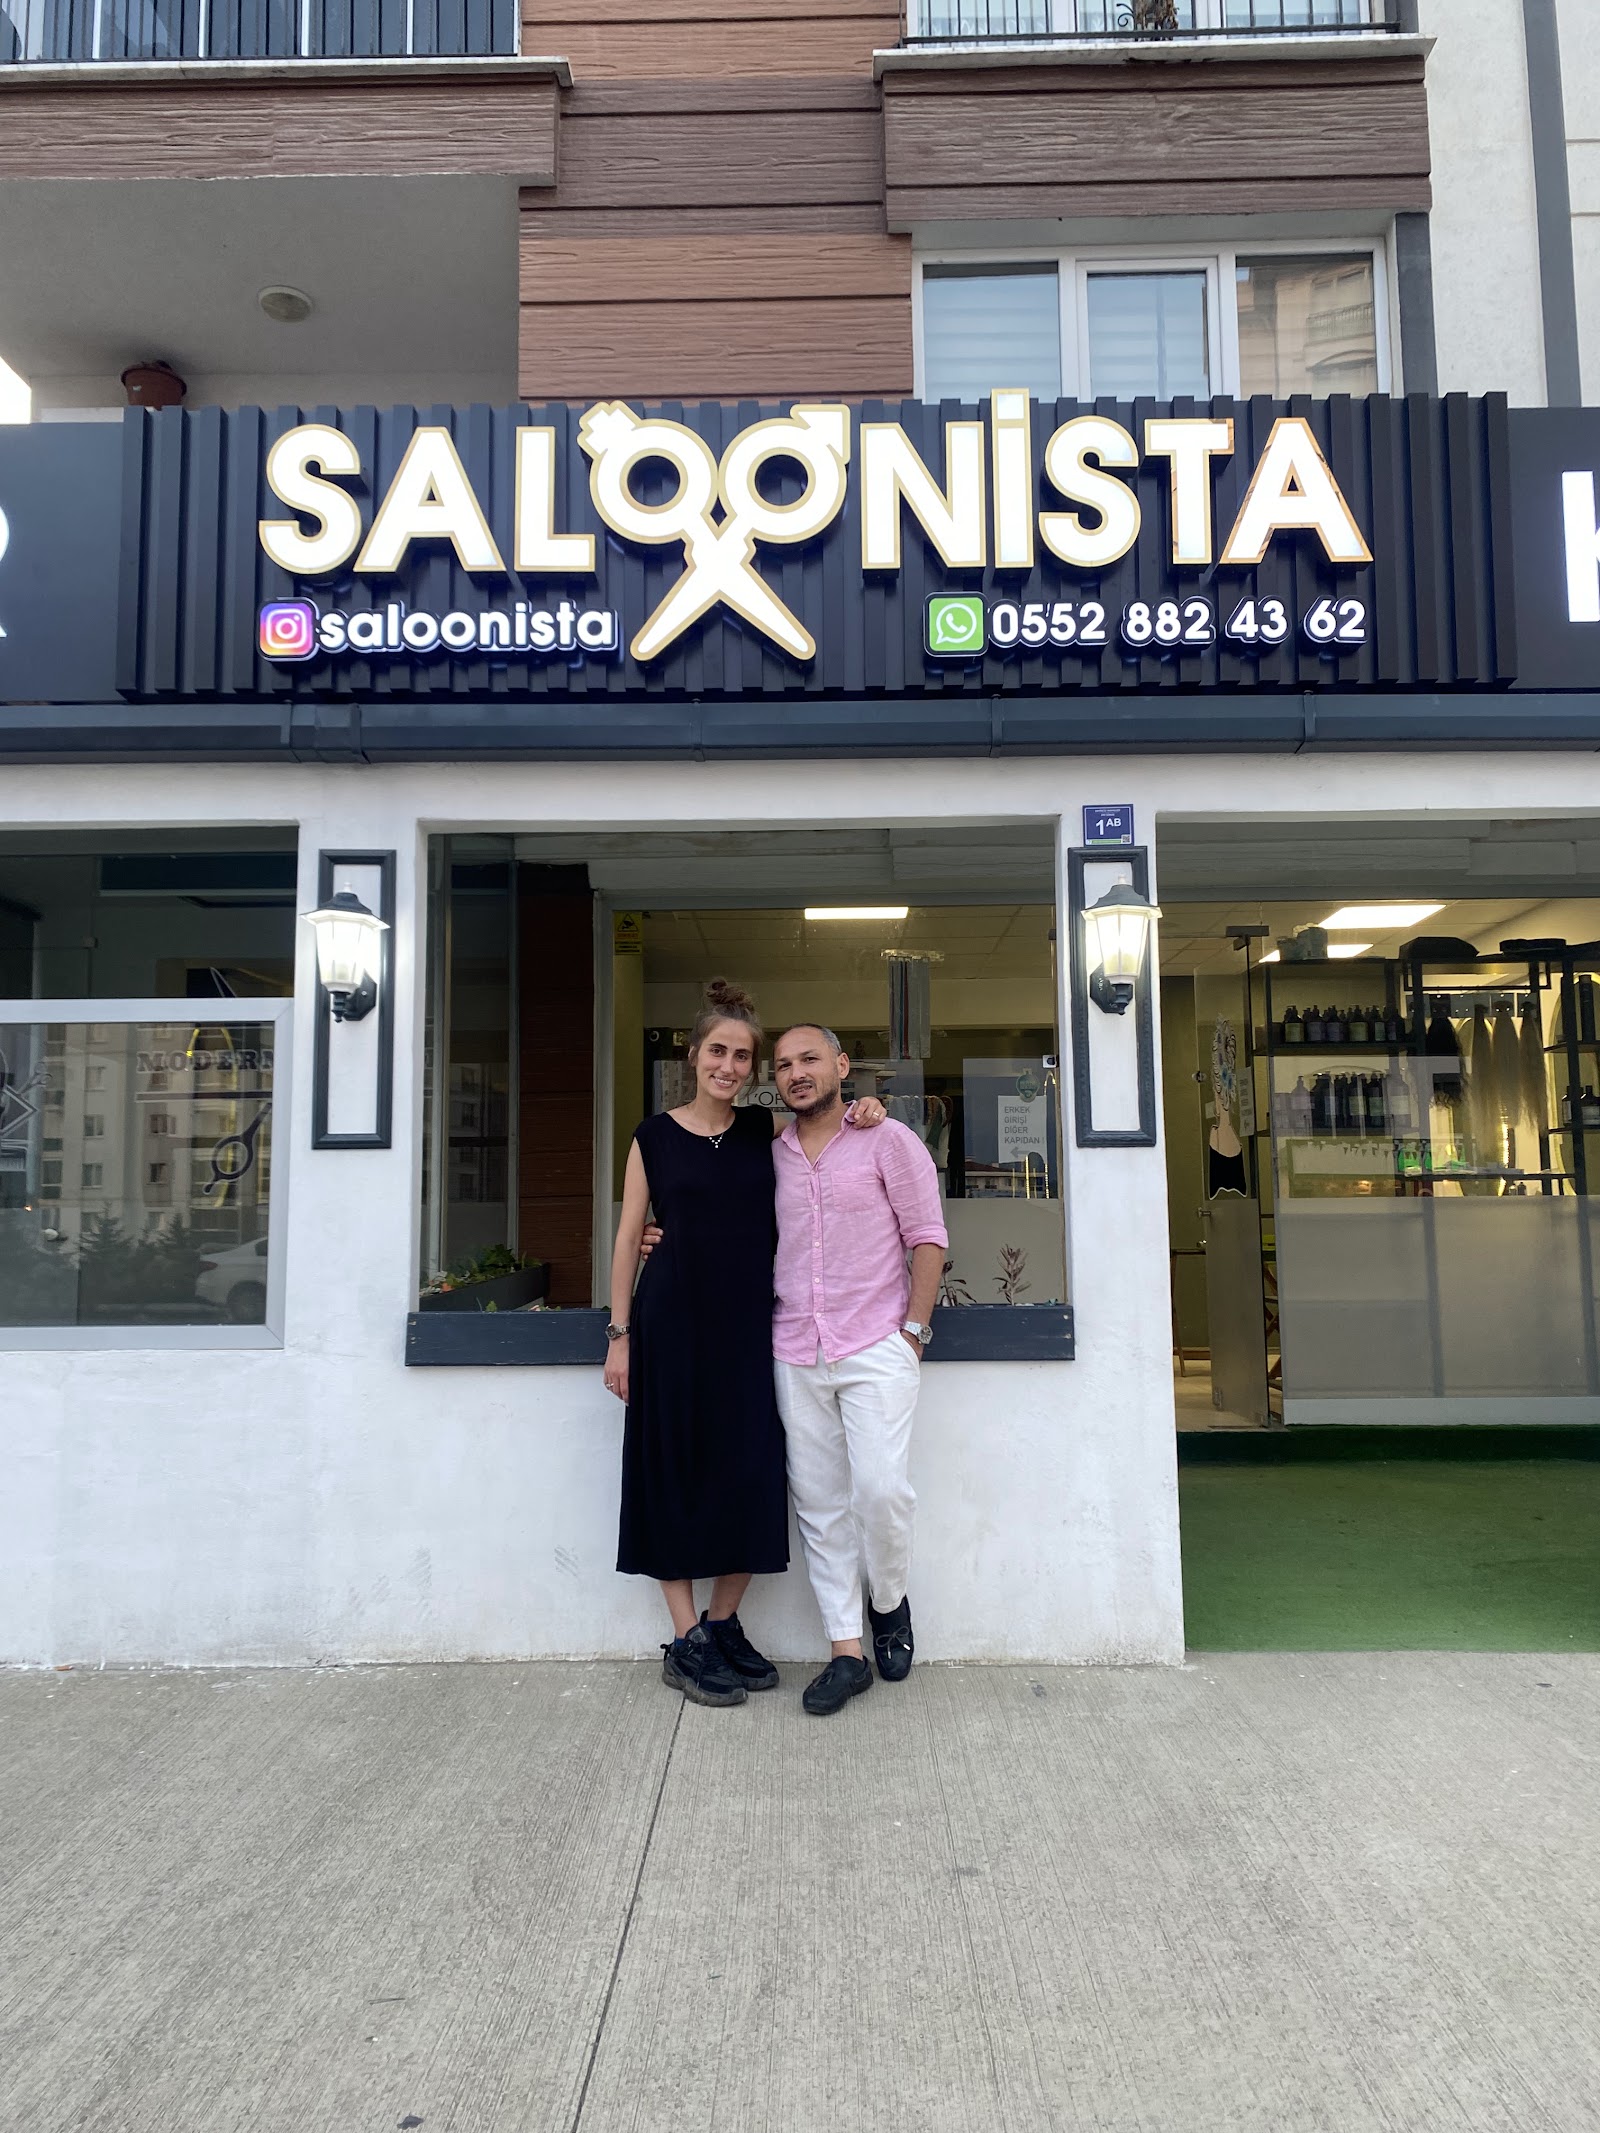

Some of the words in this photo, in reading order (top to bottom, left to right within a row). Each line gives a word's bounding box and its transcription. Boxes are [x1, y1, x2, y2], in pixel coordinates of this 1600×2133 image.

[319, 602, 614, 649] saloonista
[992, 601, 1106, 643] 0552
[1126, 601, 1210, 642] 882
[1231, 600, 1287, 640] 43
[1309, 599, 1366, 639] 62
[1004, 1106, 1031, 1114] ERKEK
[1004, 1115, 1027, 1126] GİRİŞİ
[1004, 1126, 1029, 1134] DİĞER
[1004, 1136, 1040, 1144] KAPIDAN
